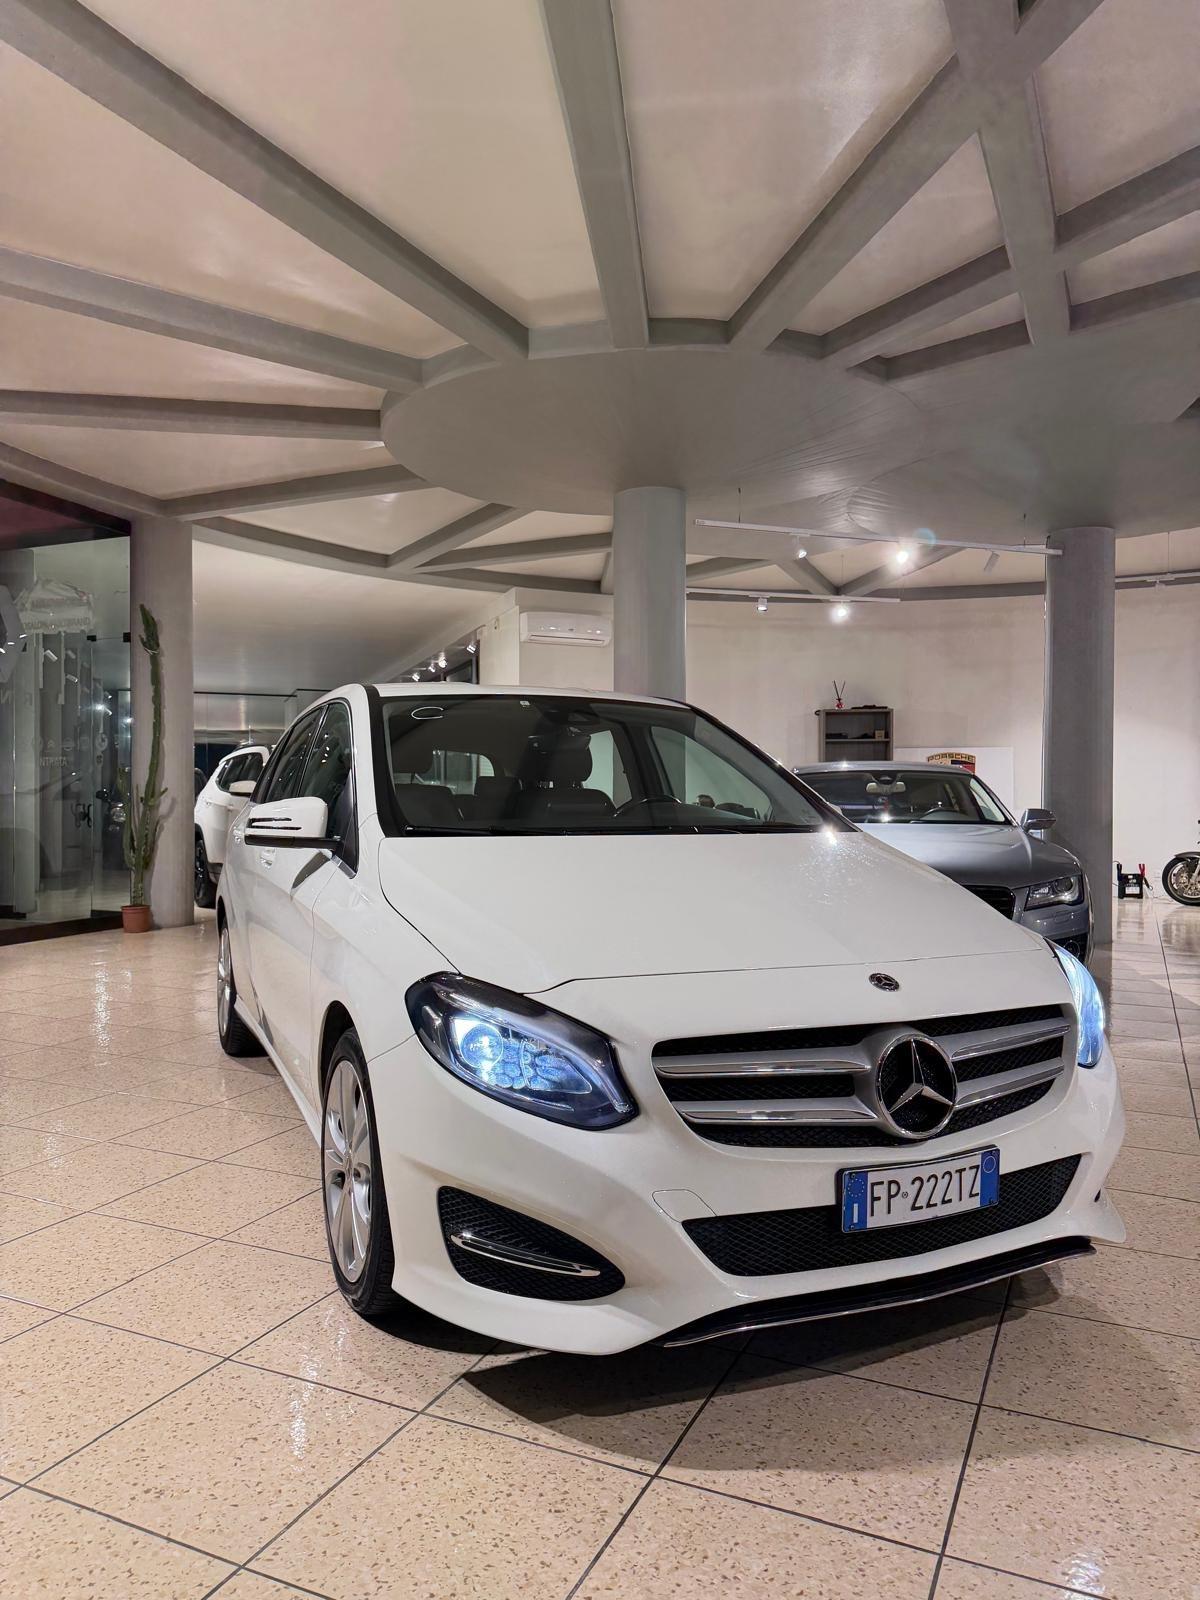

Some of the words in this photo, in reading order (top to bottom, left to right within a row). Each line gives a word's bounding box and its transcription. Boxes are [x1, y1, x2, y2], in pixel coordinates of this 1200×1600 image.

[927, 752, 975, 762] PORSCHE
[870, 1180, 901, 1217] FP
[911, 1164, 980, 1211] 222TZ
[853, 1203, 859, 1223] I
